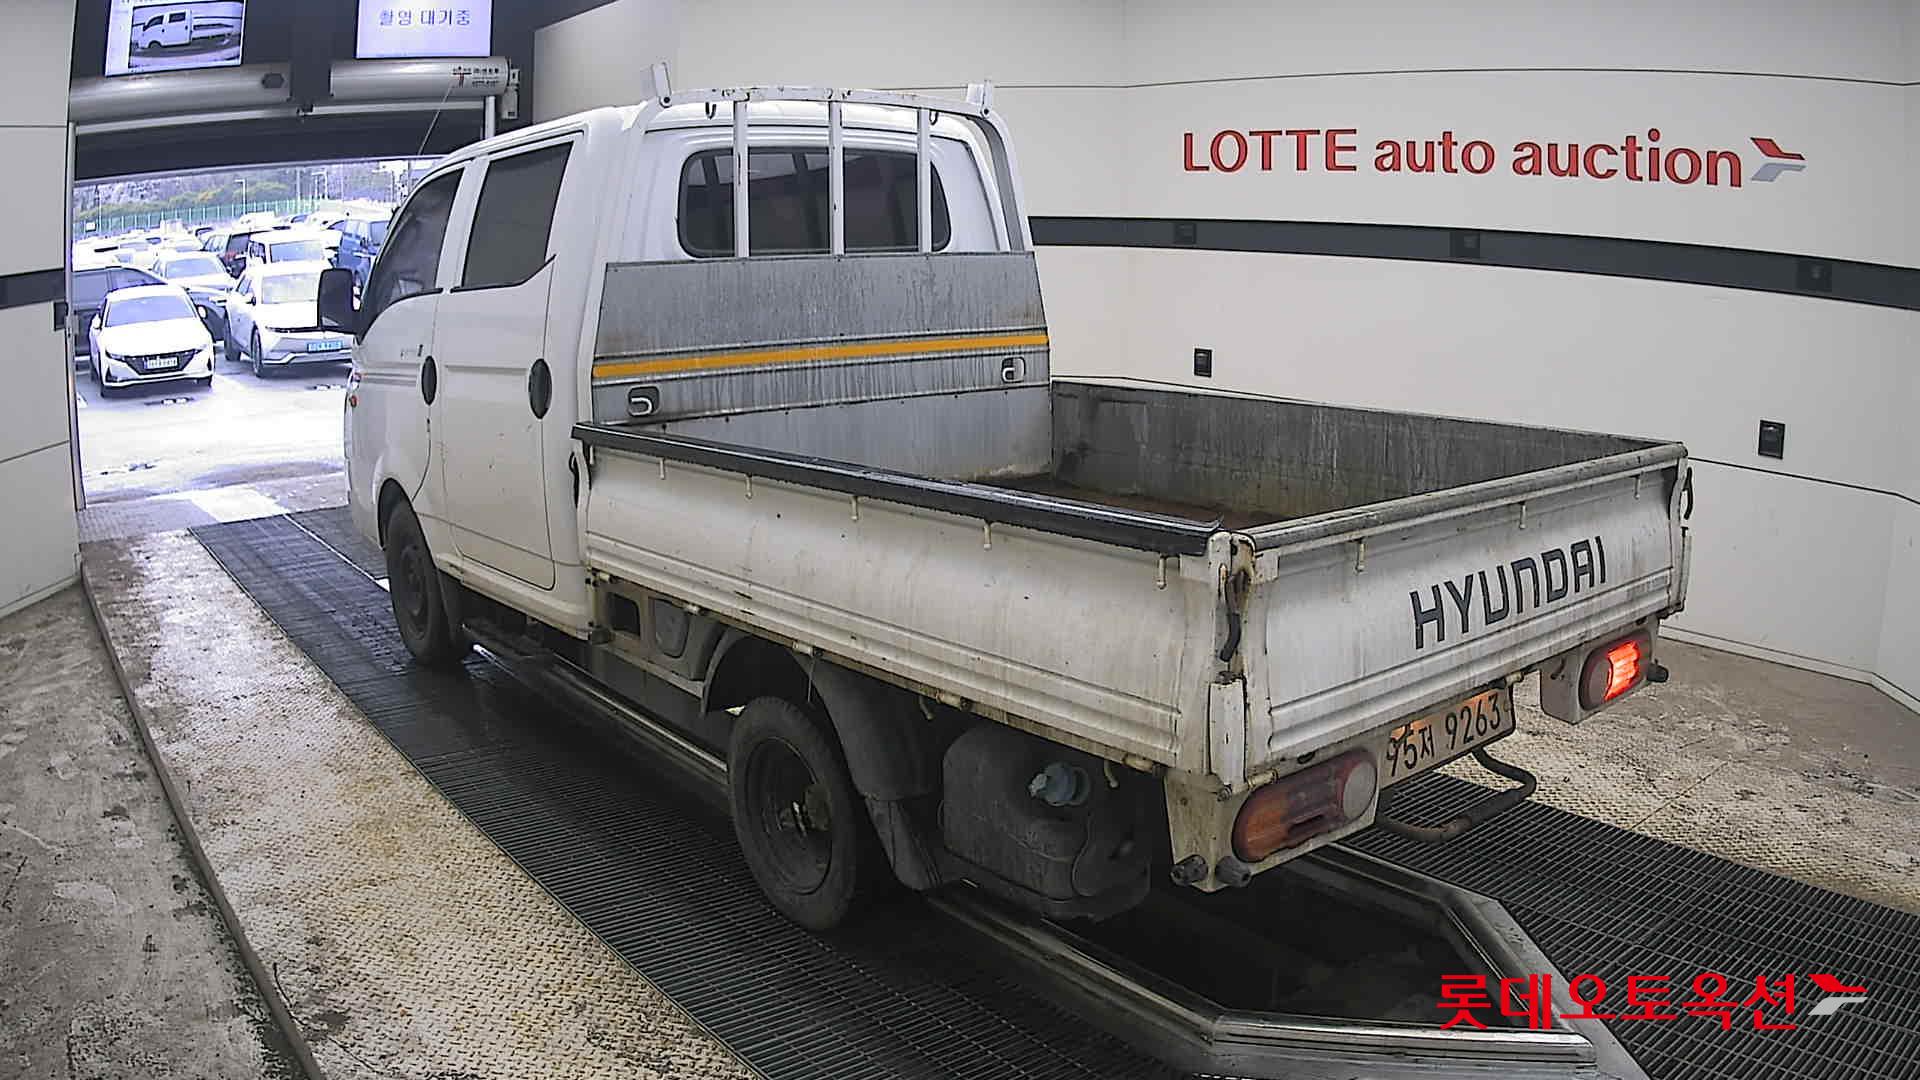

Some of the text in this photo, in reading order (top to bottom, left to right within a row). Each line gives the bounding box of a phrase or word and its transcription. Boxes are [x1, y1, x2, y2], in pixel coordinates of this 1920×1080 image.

[420, 8, 470, 26] 대기중
[1183, 127, 1743, 188] LOTTE auto auction
[1409, 535, 1607, 650] HYUNDAI
[1386, 691, 1500, 777] 95저 9263
